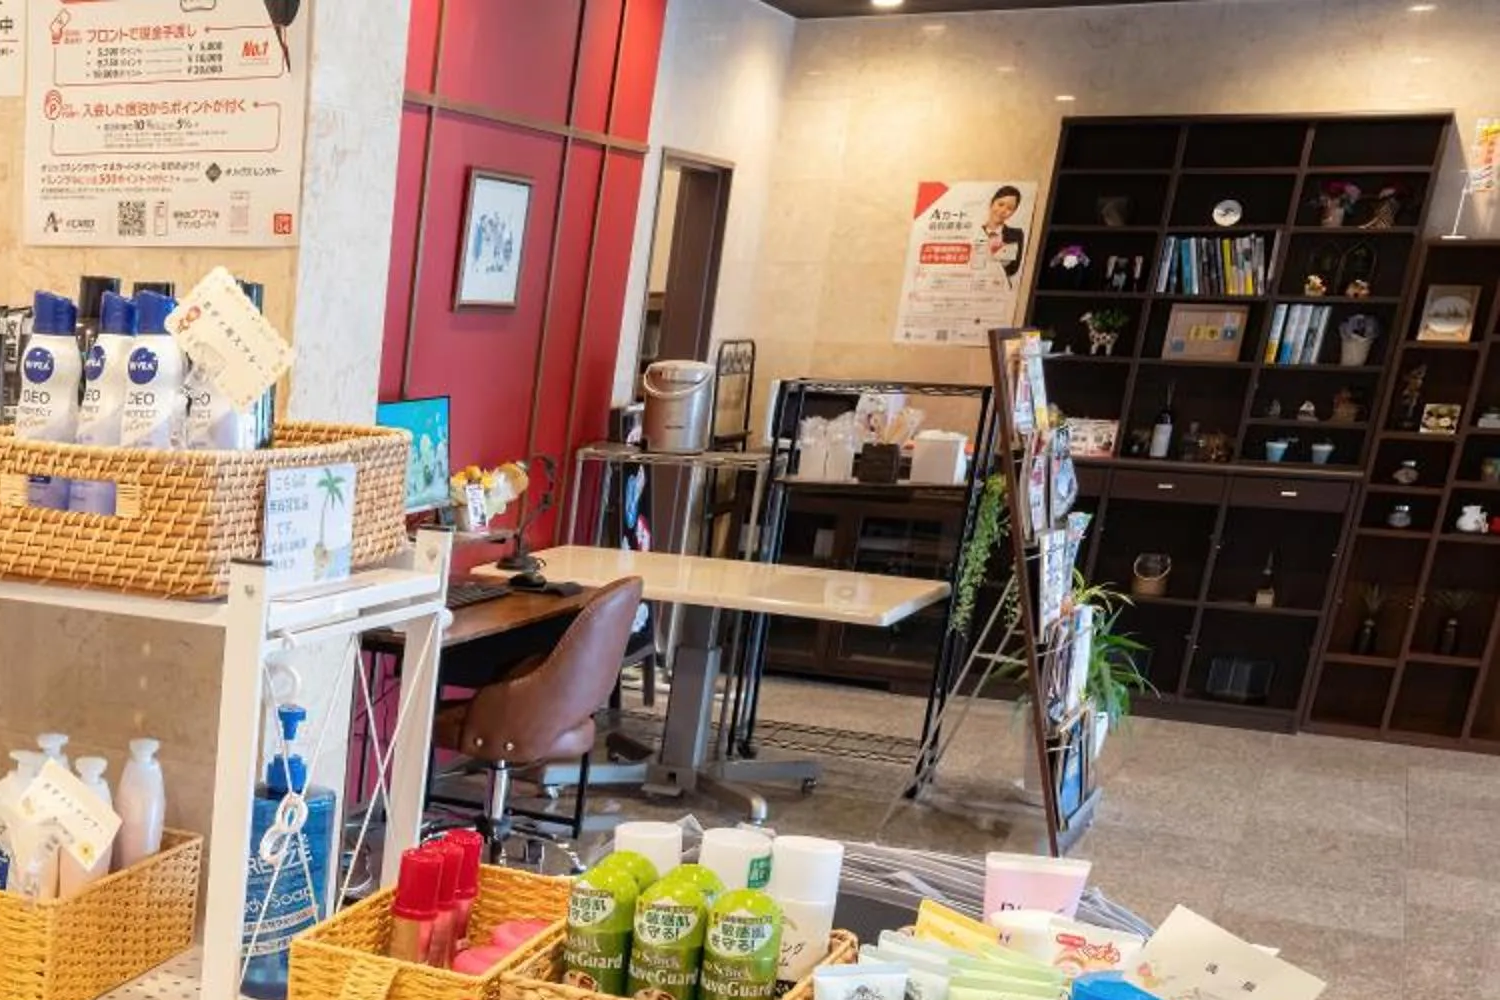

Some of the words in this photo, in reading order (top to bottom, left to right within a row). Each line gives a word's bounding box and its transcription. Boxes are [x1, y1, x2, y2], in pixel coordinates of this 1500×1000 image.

[25, 360, 50, 370] NIVEA
[129, 361, 154, 371] NIVEA
[23, 390, 50, 405] DEO
[127, 390, 155, 406] DEO
